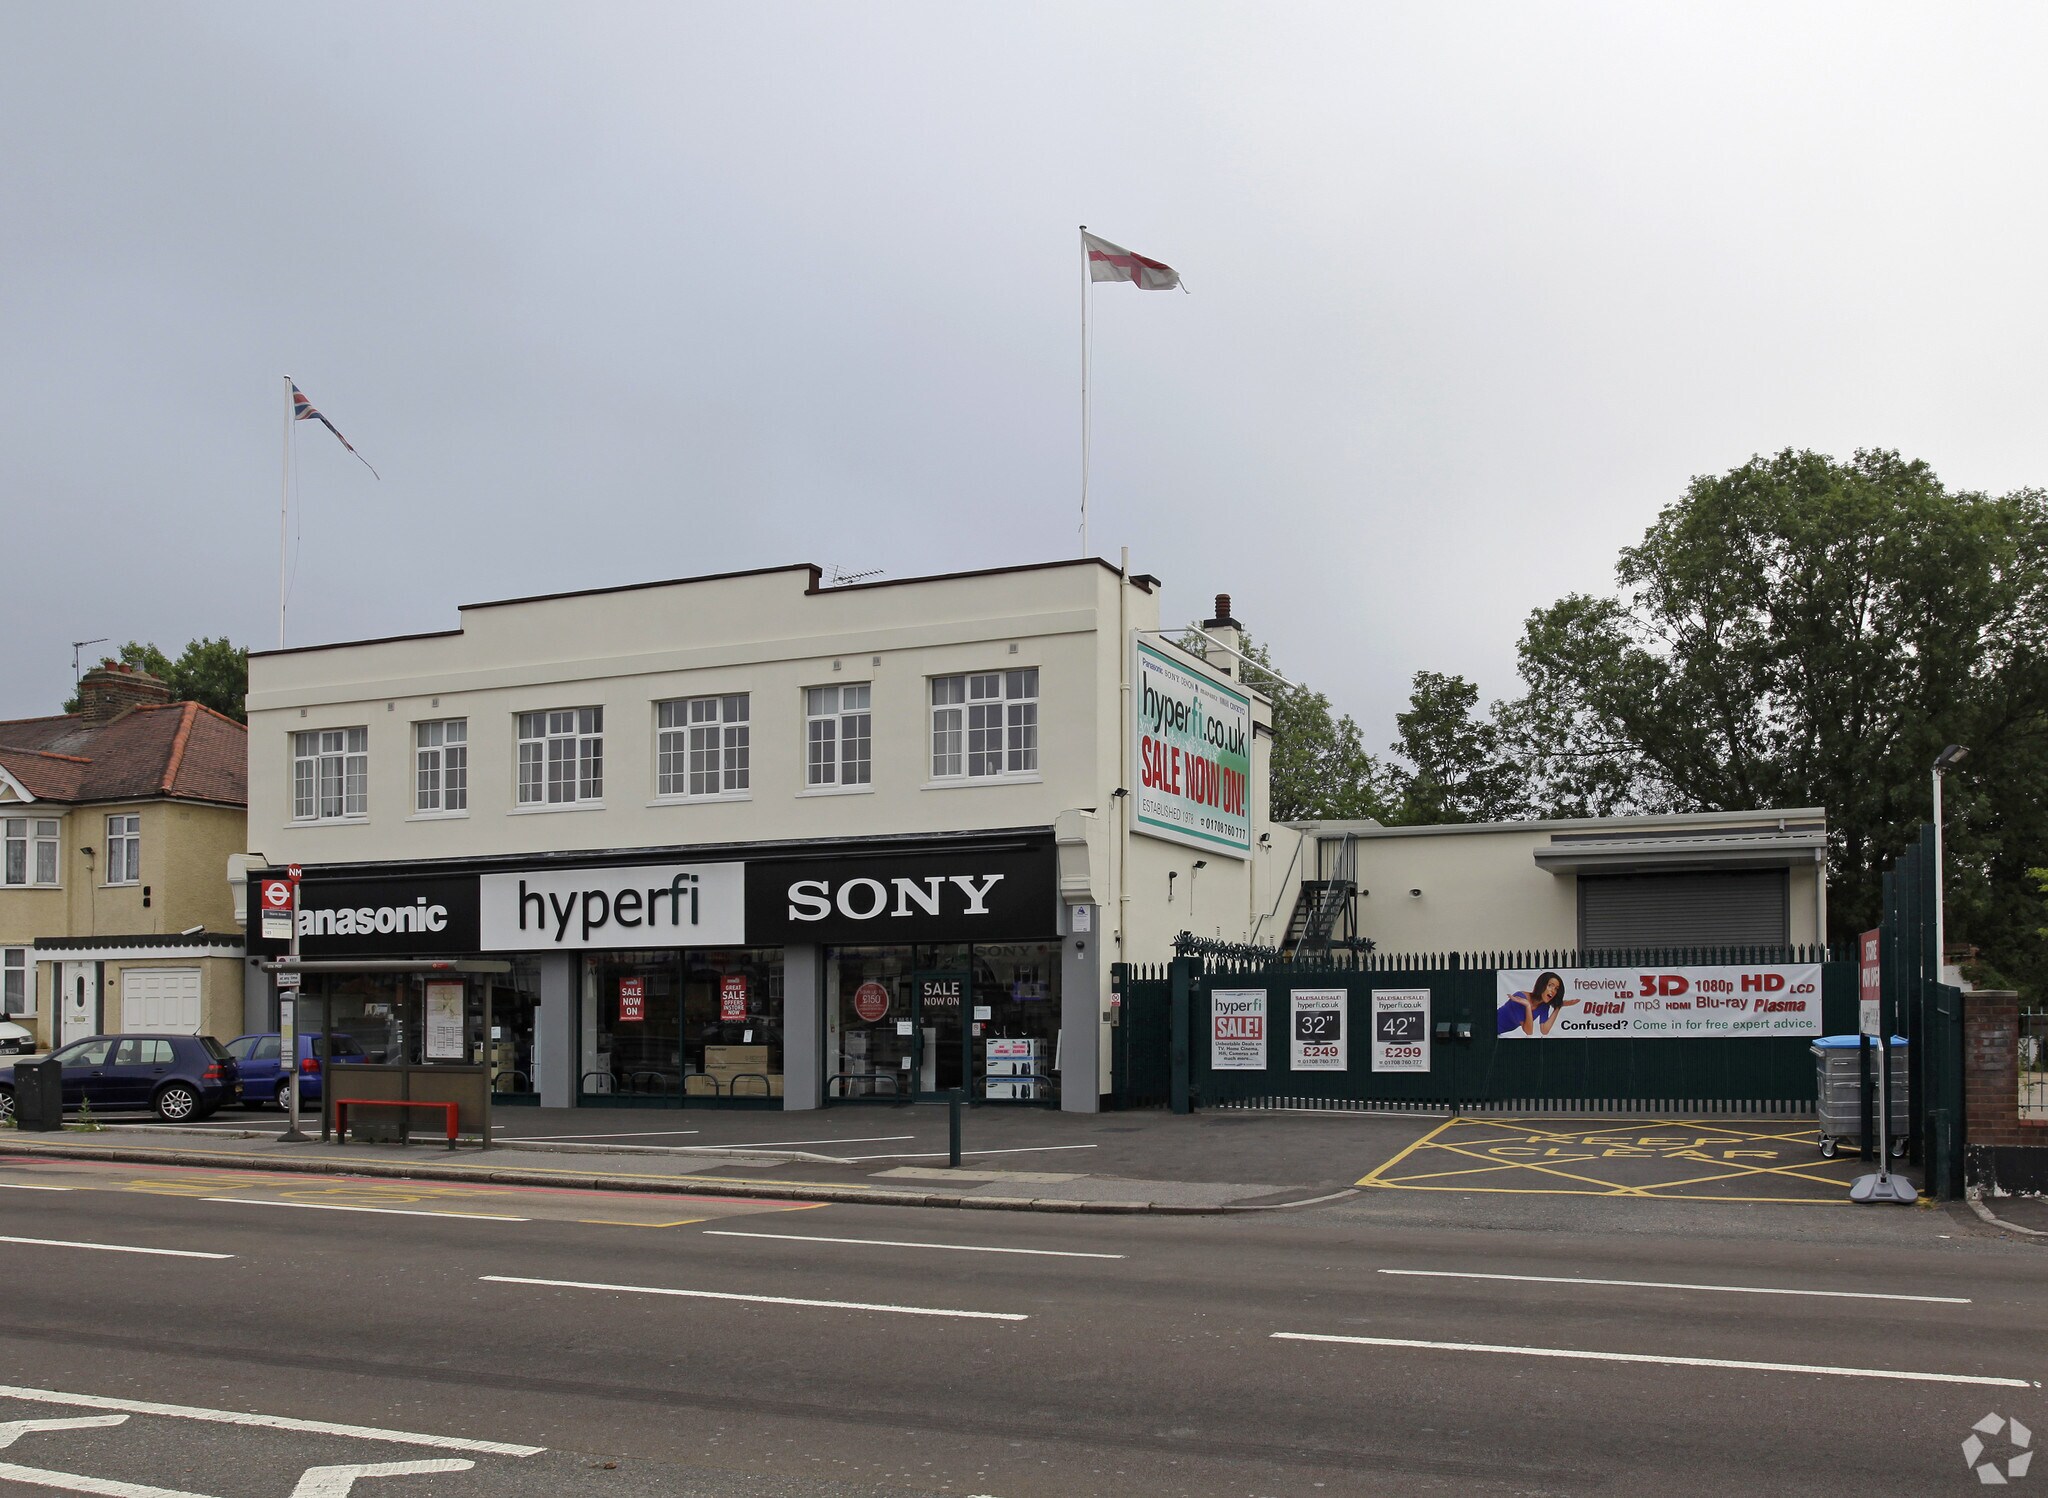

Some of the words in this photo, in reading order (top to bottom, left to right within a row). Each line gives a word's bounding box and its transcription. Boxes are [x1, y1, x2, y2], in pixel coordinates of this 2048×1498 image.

[1165, 669, 1180, 683] SONY
[1143, 671, 1246, 758] hyperfi.co.uk
[1141, 735, 1181, 796] SALE
[1184, 751, 1220, 809] NOW
[1223, 767, 1245, 817] ON!
[1142, 798, 1181, 821] ESTABLISHED
[288, 868, 302, 877] NM
[788, 874, 1005, 921] SONY
[519, 873, 699, 941] hyperfi
[299, 897, 447, 936] anasonic
[621, 987, 642, 996] SALE
[924, 982, 960, 995] SALE
[1574, 978, 1627, 990] freeview
[1639, 975, 1689, 997] 3D
[1695, 979, 1734, 994] 1080p
[1741, 973, 1785, 992] HD
[1789, 983, 1815, 994] LCD
[622, 997, 642, 1005] NOW
[722, 991, 745, 1000] SALE
[862, 995, 881, 1004] £150
[924, 997, 945, 1006] NOW
[947, 997, 960, 1006] ON
[1614, 991, 1634, 999] LED
[626, 1007, 638, 1015] ON
[1215, 998, 1262, 1015] hyperfi
[1378, 1001, 1422, 1009] hyperfi.co.uk
[1583, 1001, 1626, 1016] Digital
[1634, 1000, 1660, 1011] mp3
[1665, 1002, 1691, 1010] HDMI
[1696, 996, 1748, 1011] Blu-ray
[1753, 999, 1807, 1013] Plasma
[1217, 1017, 1259, 1037] SALE!
[1561, 1020, 1628, 1030] Confused?
[1633, 1019, 1667, 1030] Come
[1671, 1019, 1682, 1029] in
[1686, 1019, 1702, 1029] for
[1706, 1019, 1729, 1029] free
[1733, 1019, 1770, 1031] expert
[1773, 1018, 1817, 1029] advice.
[1303, 1046, 1339, 1057] £249
[1385, 1047, 1422, 1058] £299
[1526, 1136, 1747, 1146] KEEP
[1488, 1147, 1779, 1160] CLEAR
